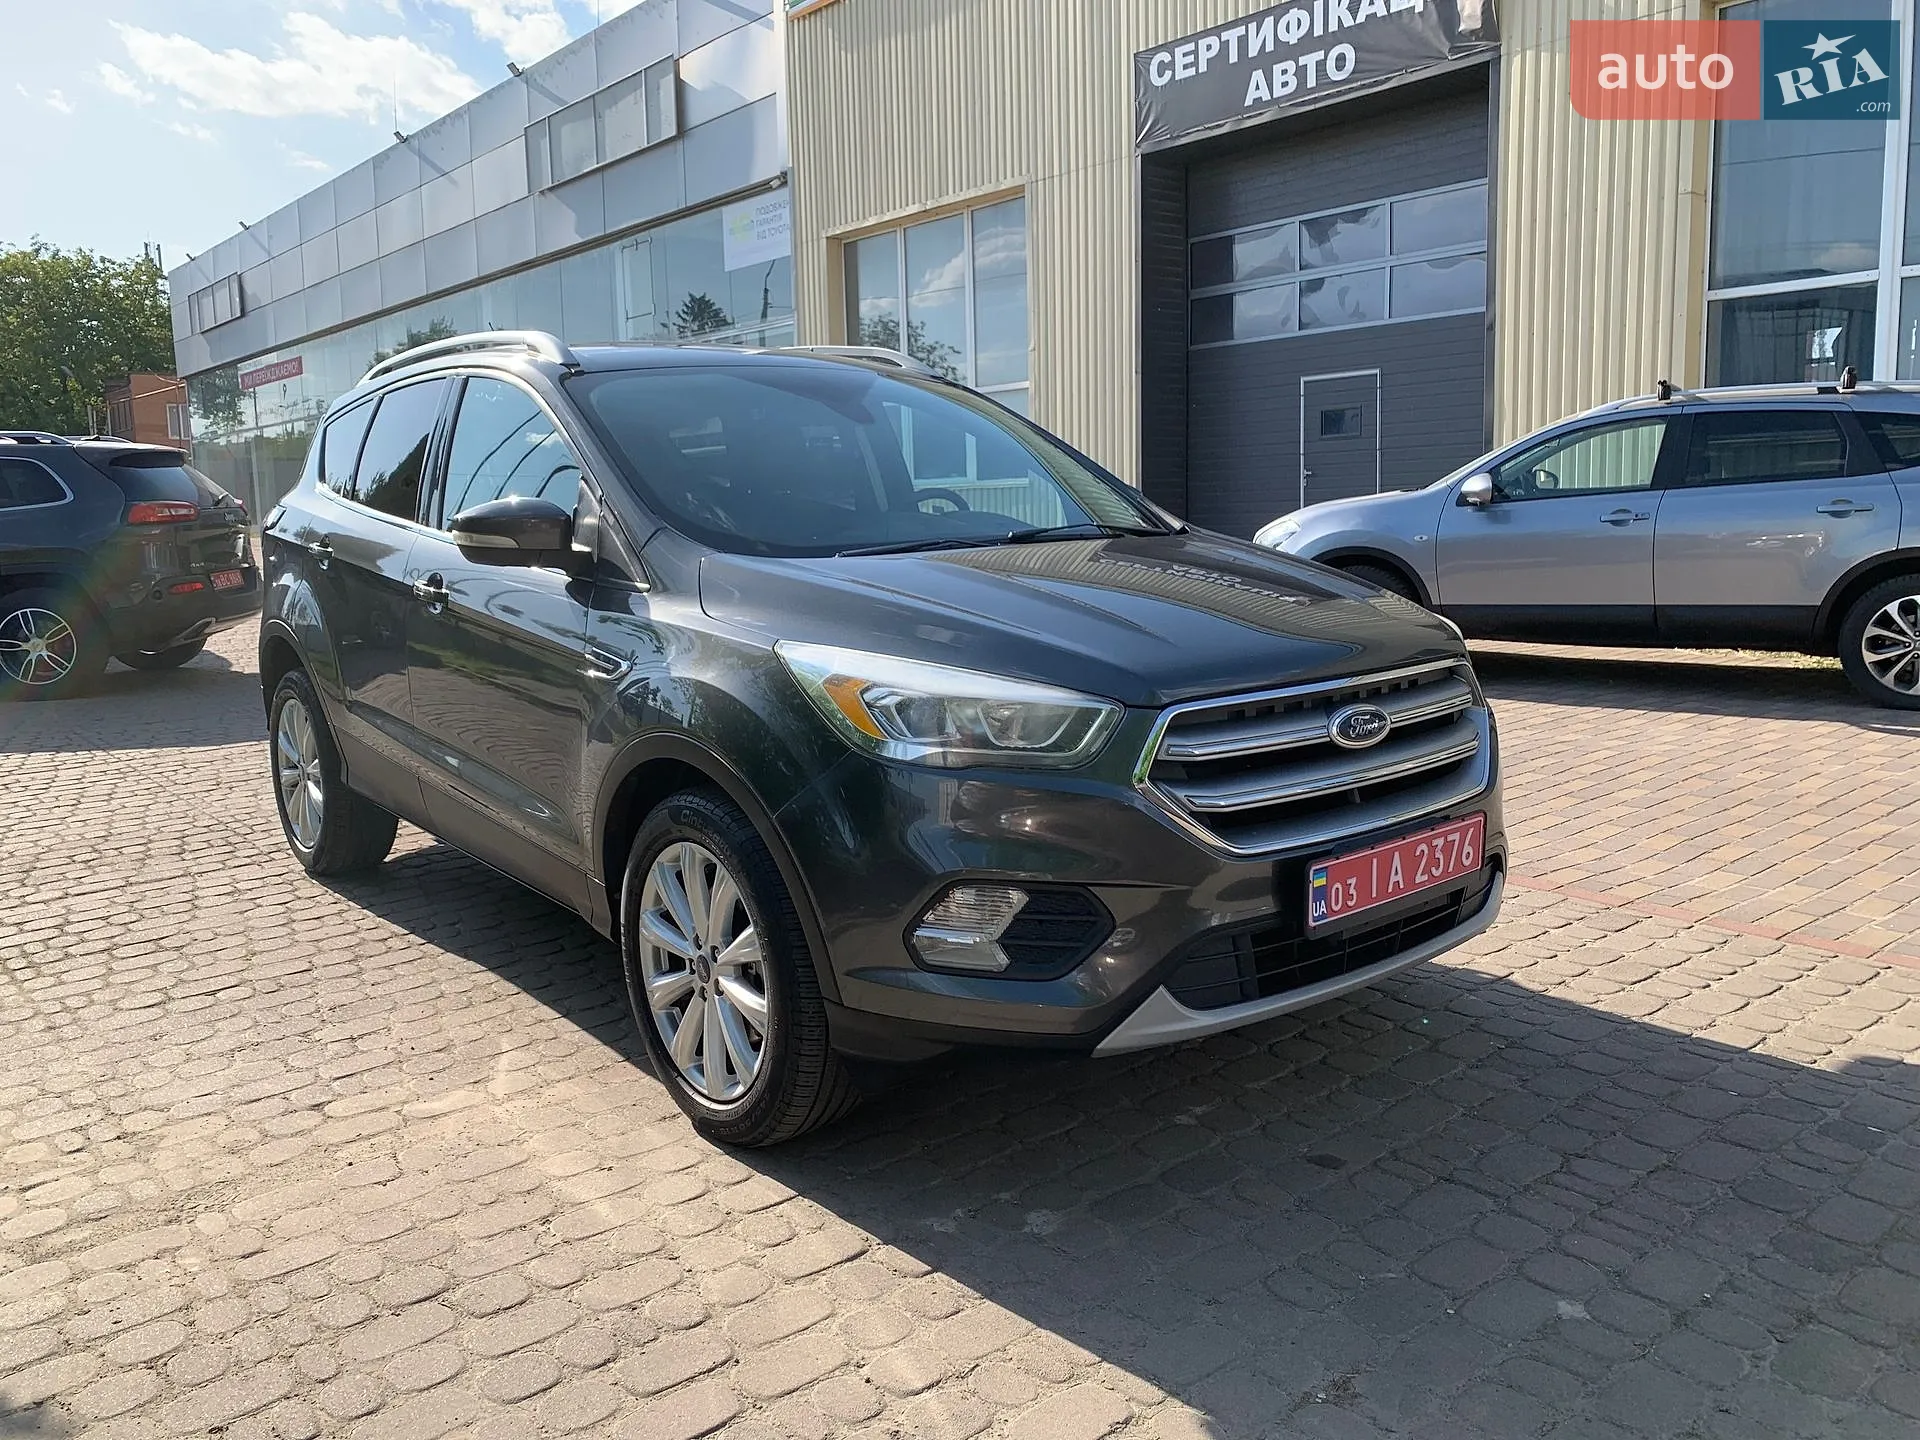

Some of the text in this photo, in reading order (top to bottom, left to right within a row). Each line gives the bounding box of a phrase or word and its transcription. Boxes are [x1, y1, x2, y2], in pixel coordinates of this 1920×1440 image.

[1244, 43, 1357, 107] АВТО
[1350, 714, 1387, 738] Ford
[1330, 827, 1475, 912] 03 IA 2376
[1312, 900, 1327, 917] UA
